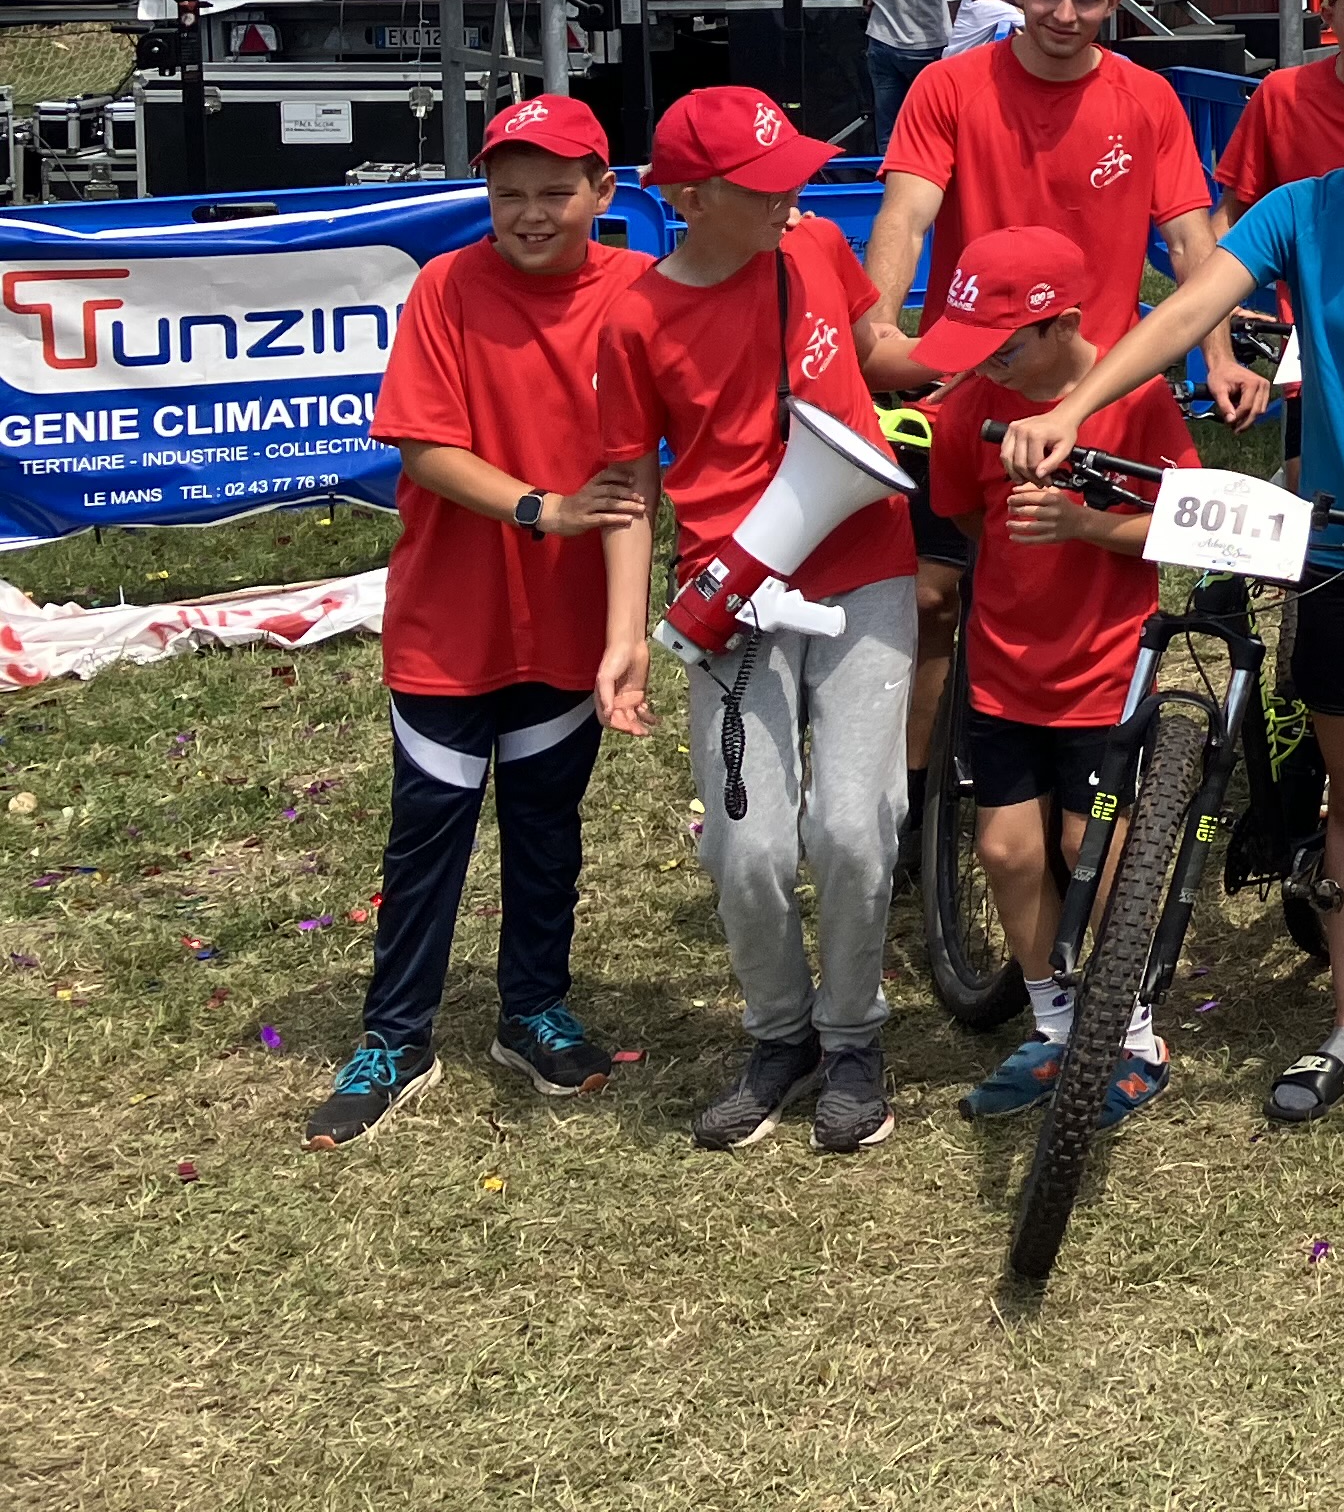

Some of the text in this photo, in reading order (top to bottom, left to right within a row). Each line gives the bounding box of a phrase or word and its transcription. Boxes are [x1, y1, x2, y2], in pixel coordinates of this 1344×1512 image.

[1, 408, 140, 447] GENIE
[20, 456, 125, 475] TERTIAIRE
[142, 447, 248, 467] INDUSTRIE
[84, 492, 105, 507] LE
[110, 488, 163, 504] MANS
[224, 482, 245, 496] 02
[248, 480, 269, 495] 43
[272, 478, 292, 492] 77
[296, 476, 316, 489] 76
[319, 473, 339, 488] 30
[1174, 496, 1285, 541] 801.1
[1299, 1055, 1327, 1069] NIKE
